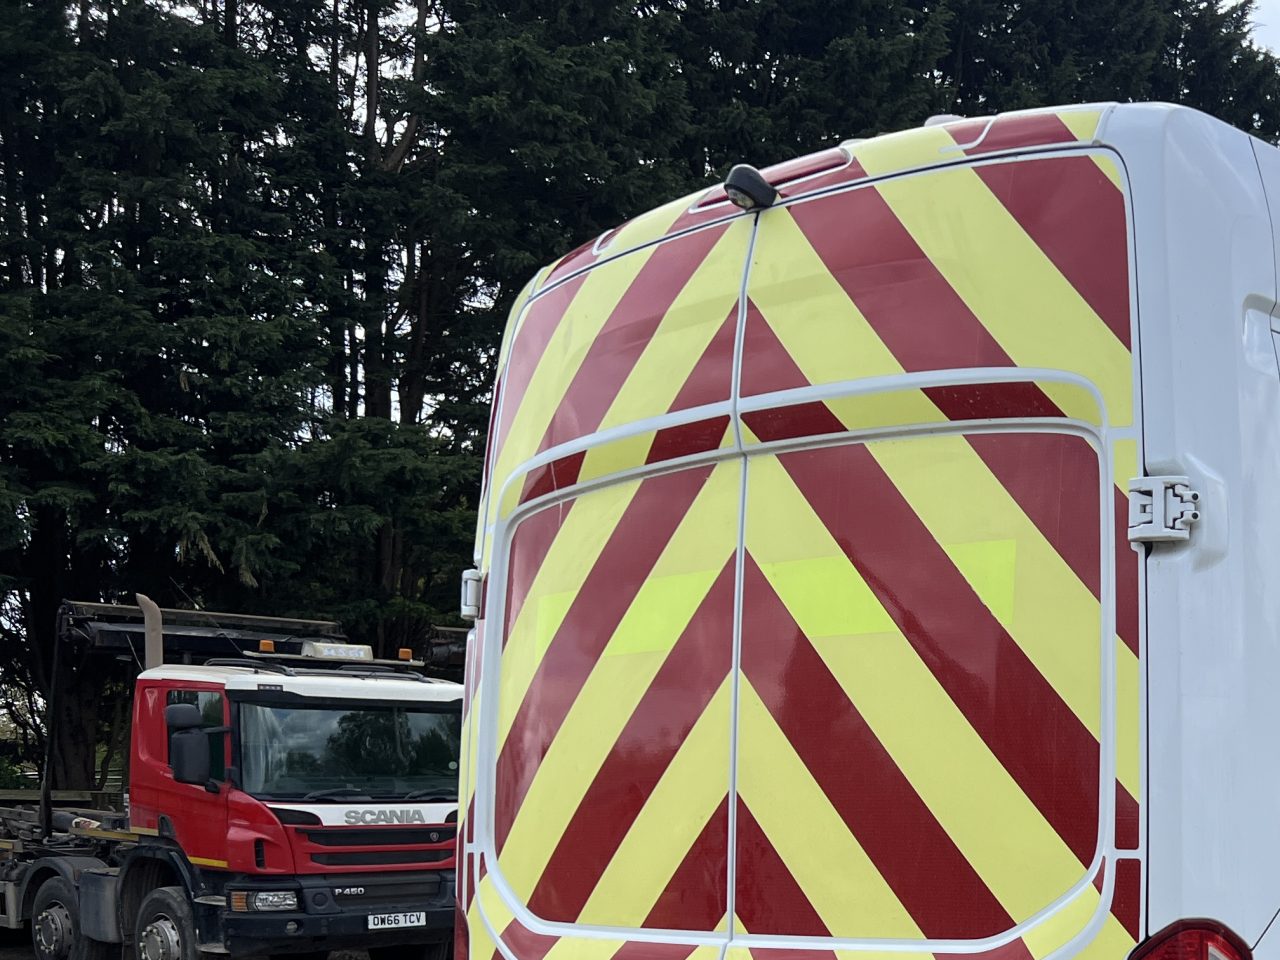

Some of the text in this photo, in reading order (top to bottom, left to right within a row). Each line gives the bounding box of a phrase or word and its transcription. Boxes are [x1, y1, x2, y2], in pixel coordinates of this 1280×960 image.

[344, 809, 426, 825] SCANIA
[343, 887, 365, 895] 450
[402, 912, 421, 924] TCV
